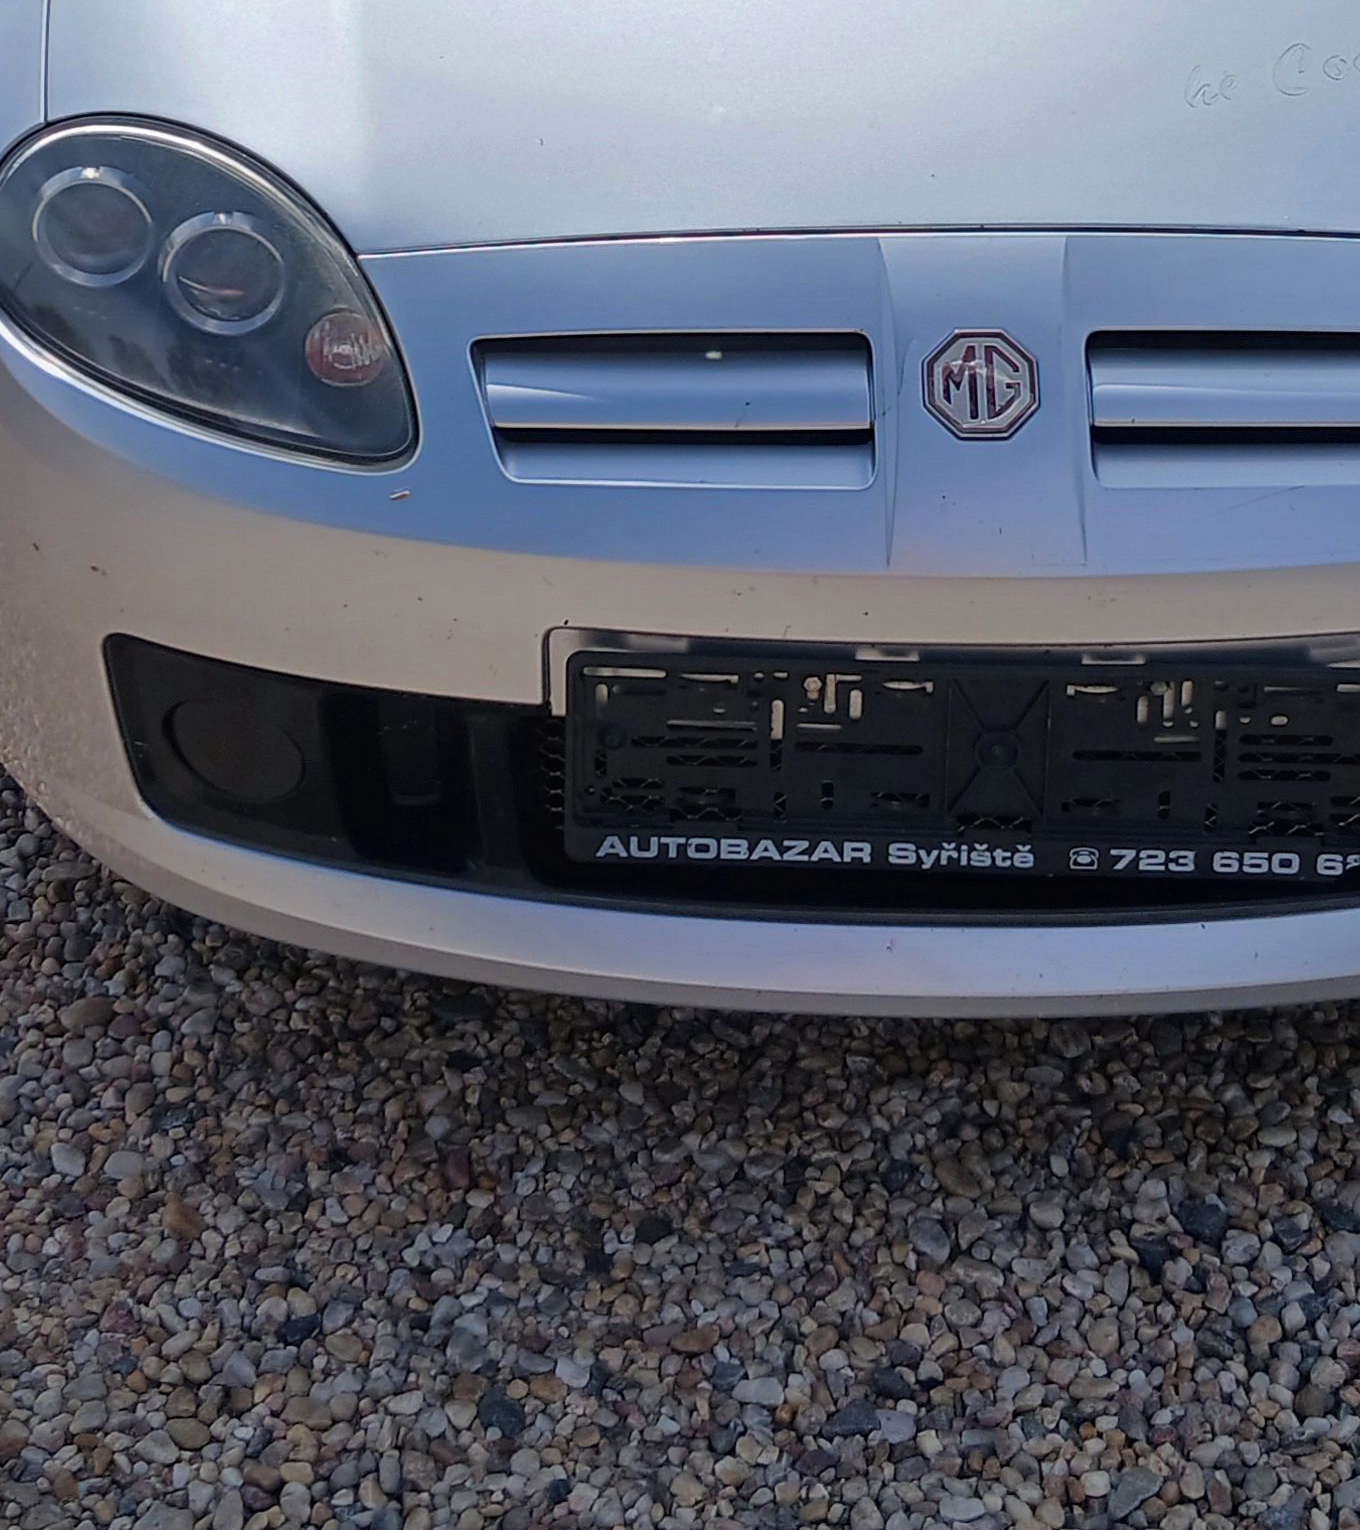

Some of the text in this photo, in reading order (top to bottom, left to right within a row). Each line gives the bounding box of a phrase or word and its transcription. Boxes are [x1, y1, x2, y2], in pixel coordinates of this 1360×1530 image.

[942, 344, 1022, 421] MG
[595, 835, 872, 864] AUTOBAZAR
[887, 842, 1036, 870] Syřiště
[1109, 848, 1196, 872] 723
[1212, 850, 1301, 874] 650
